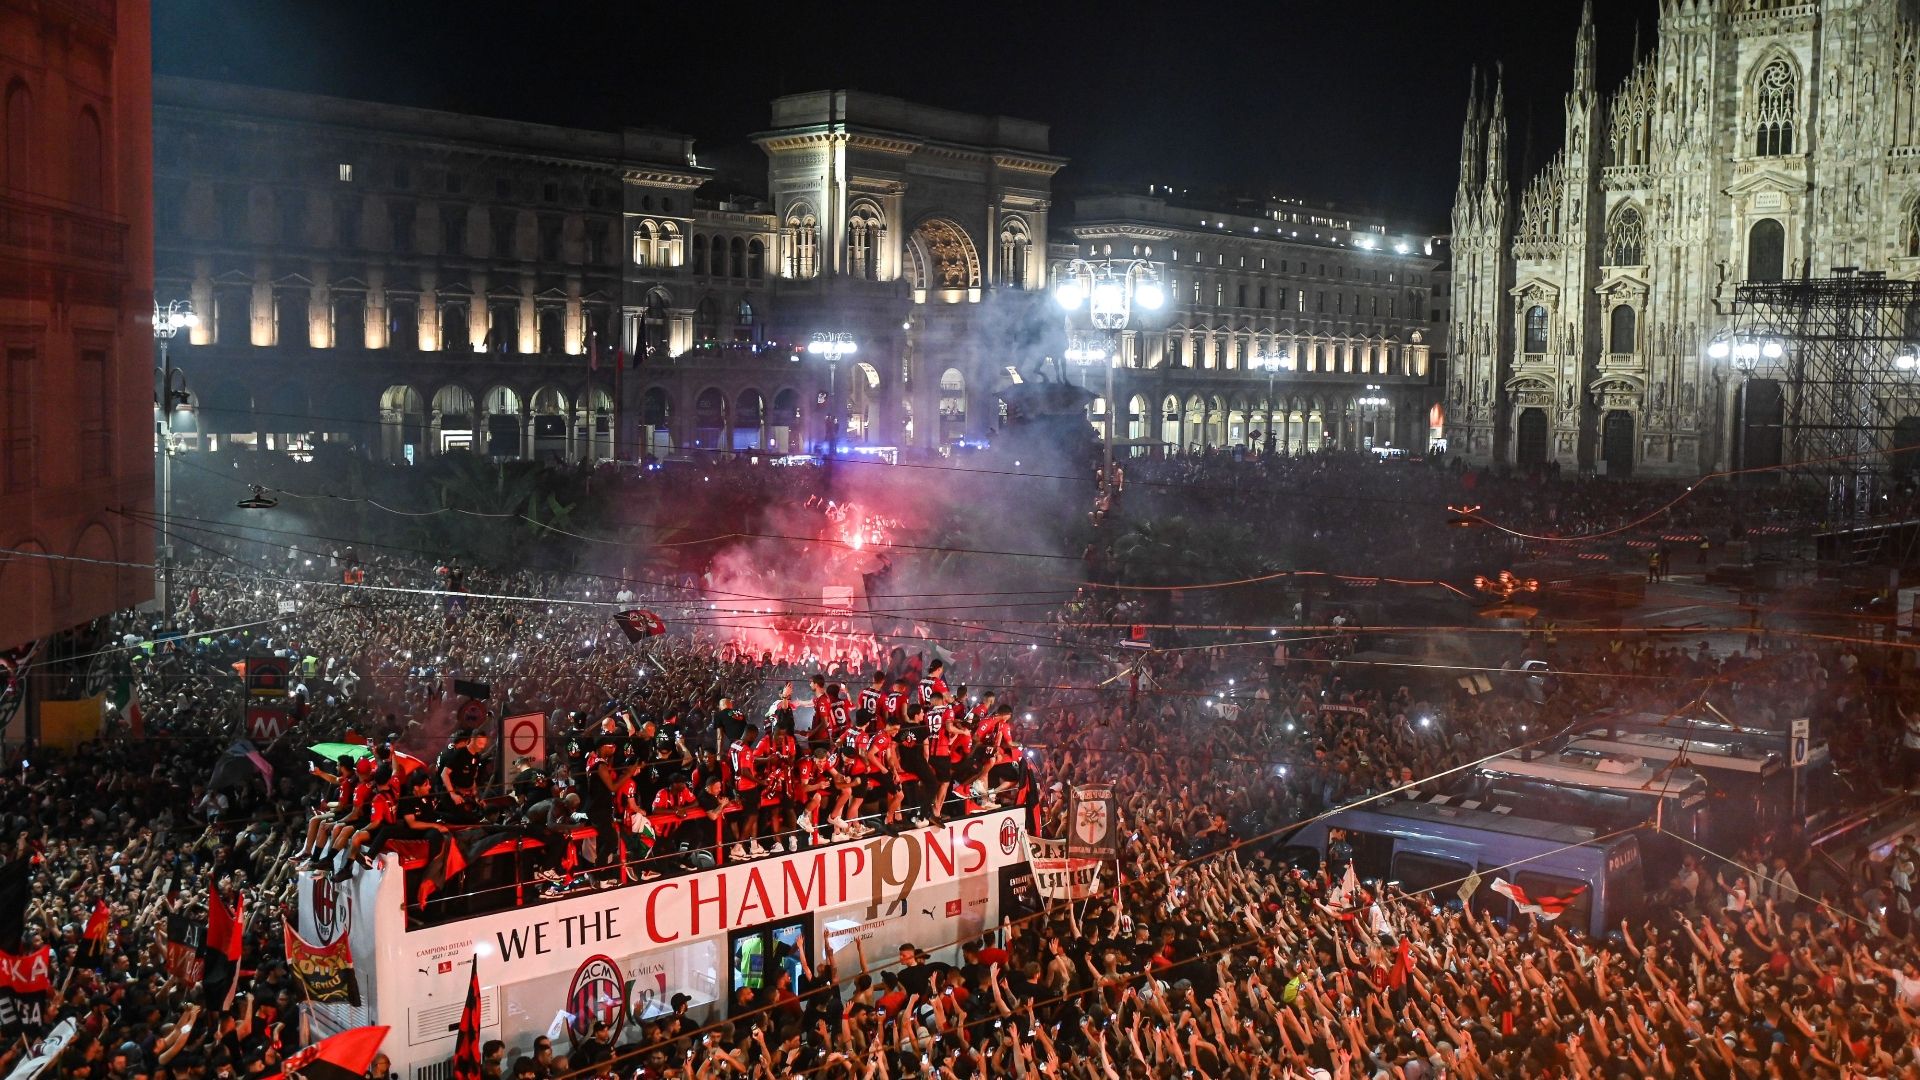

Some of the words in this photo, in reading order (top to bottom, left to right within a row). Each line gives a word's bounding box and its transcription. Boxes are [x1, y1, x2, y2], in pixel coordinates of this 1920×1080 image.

[1609, 847, 1637, 871] POLIZIA
[496, 922, 551, 962] WE
[559, 907, 621, 948] THE
[416, 945, 448, 957] CAMPIONI
[580, 963, 612, 986] ACM
